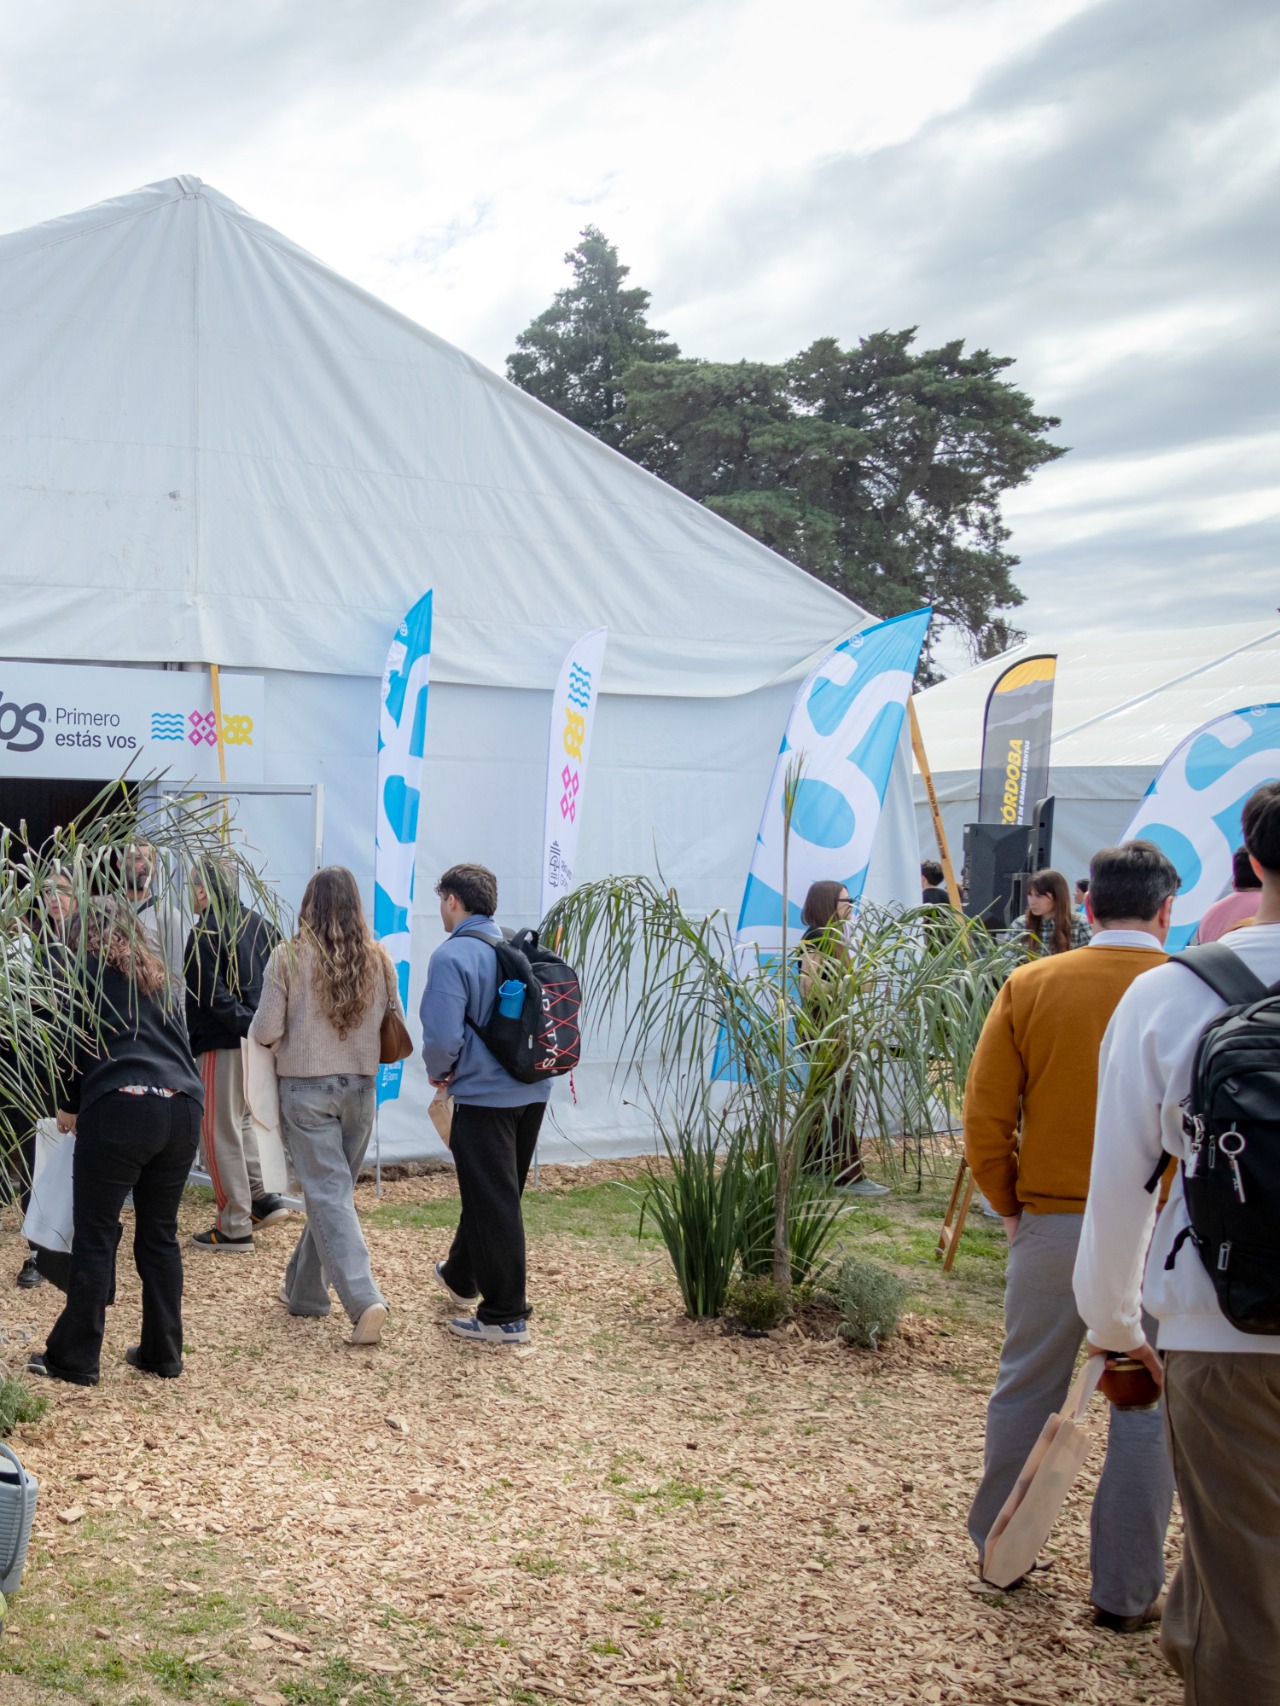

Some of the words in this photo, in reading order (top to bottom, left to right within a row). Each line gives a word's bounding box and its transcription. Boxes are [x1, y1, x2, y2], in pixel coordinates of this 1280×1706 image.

[56, 708, 120, 727] Primero
[55, 730, 102, 748] estás
[107, 733, 137, 749] vos
